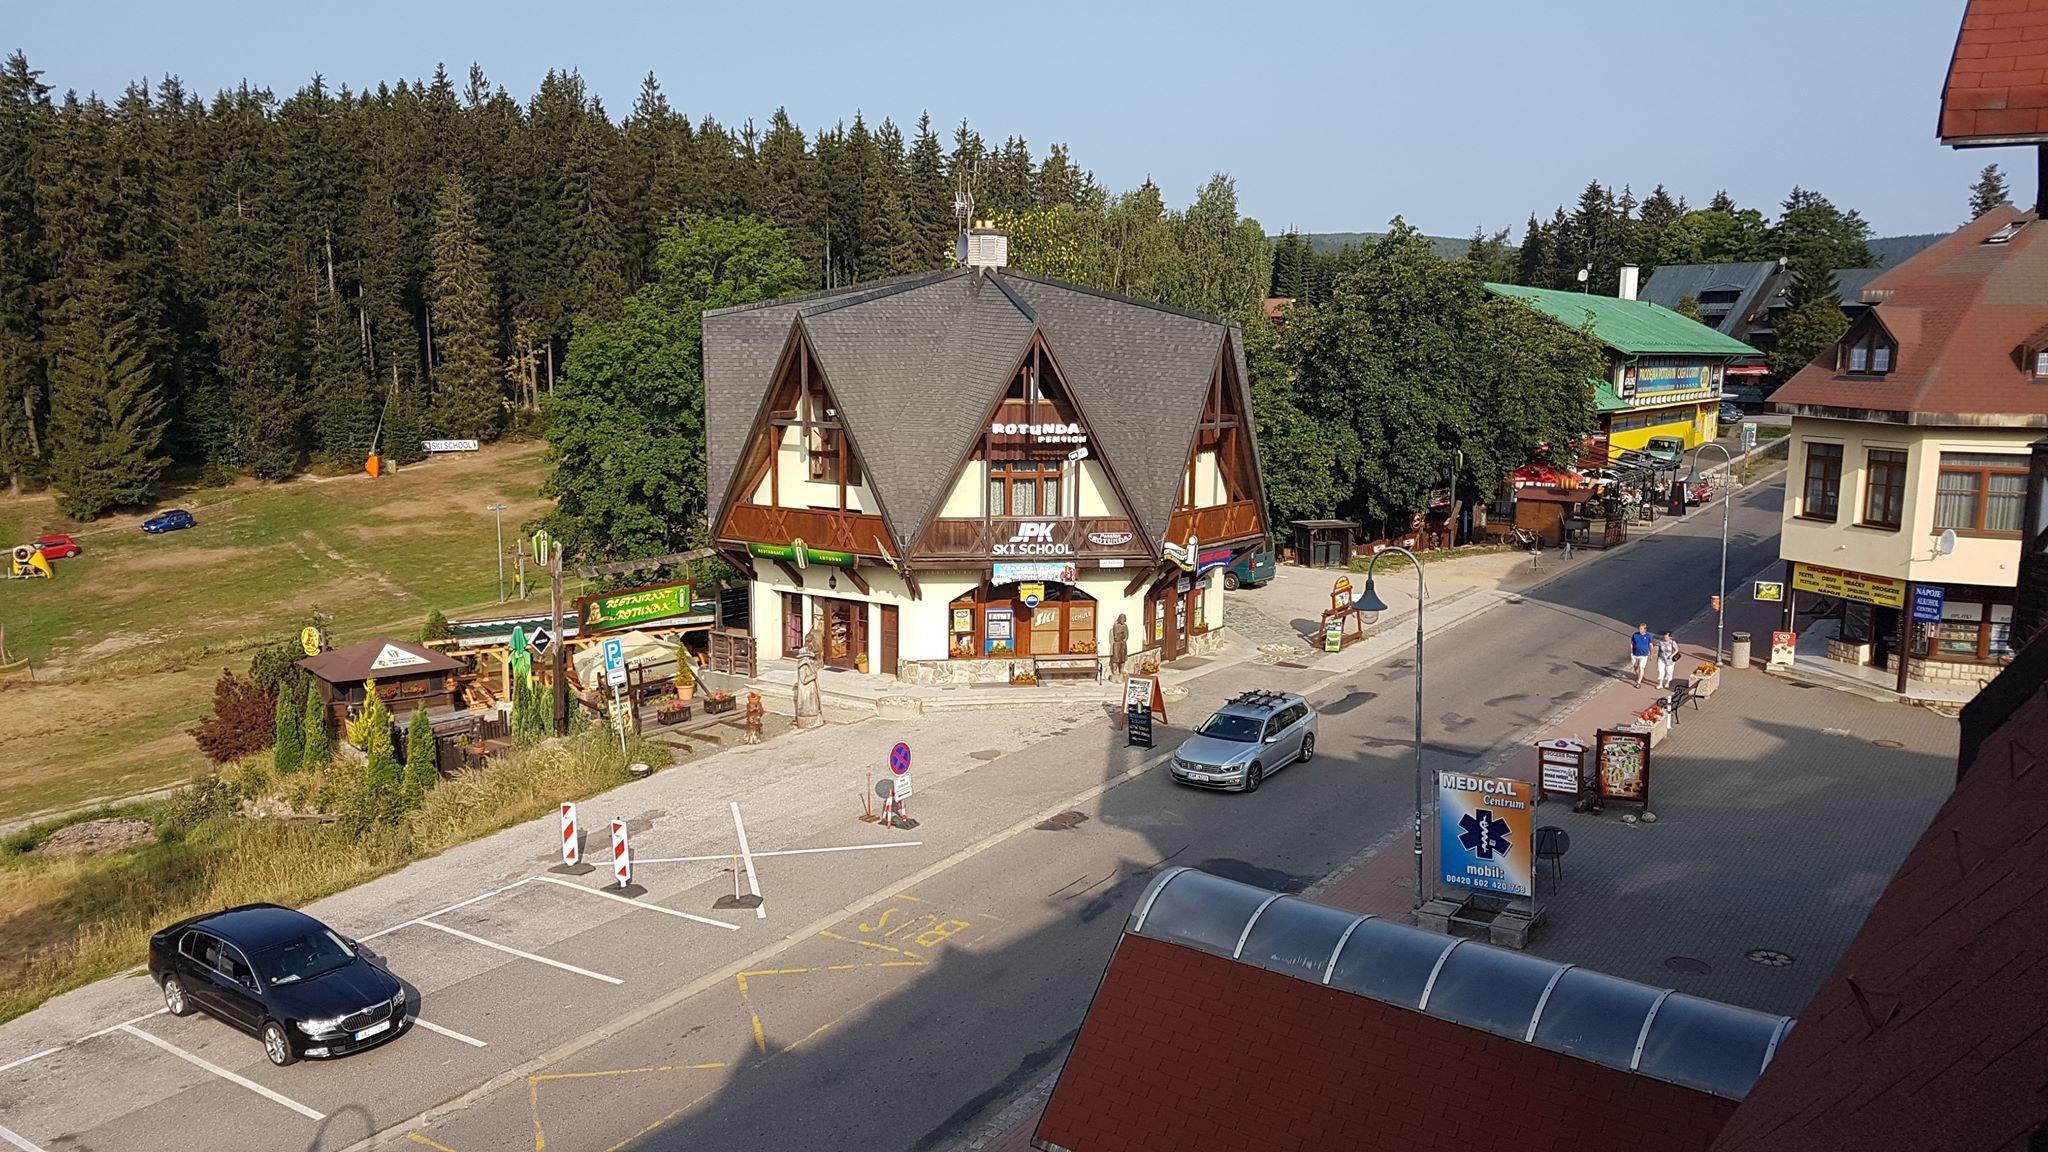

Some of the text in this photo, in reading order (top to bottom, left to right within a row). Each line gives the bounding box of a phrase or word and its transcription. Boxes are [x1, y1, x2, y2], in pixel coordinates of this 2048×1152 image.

[992, 423, 1080, 435] ROTUNDA
[432, 441, 472, 449] SKI SCHOOL
[1037, 435, 1087, 443] PENSION
[1009, 522, 1056, 543] JPK
[992, 544, 1074, 555] SKI SCHOOL
[1915, 587, 1942, 598] NÁPOJE
[1034, 611, 1056, 627] SKI
[1443, 775, 1517, 796] MEDICAL
[1483, 795, 1525, 809] Centrum
[1467, 865, 1505, 879] mobil:
[1446, 875, 1471, 885] 00420
[1474, 877, 1489, 887] 602
[1492, 881, 1507, 890] 420
